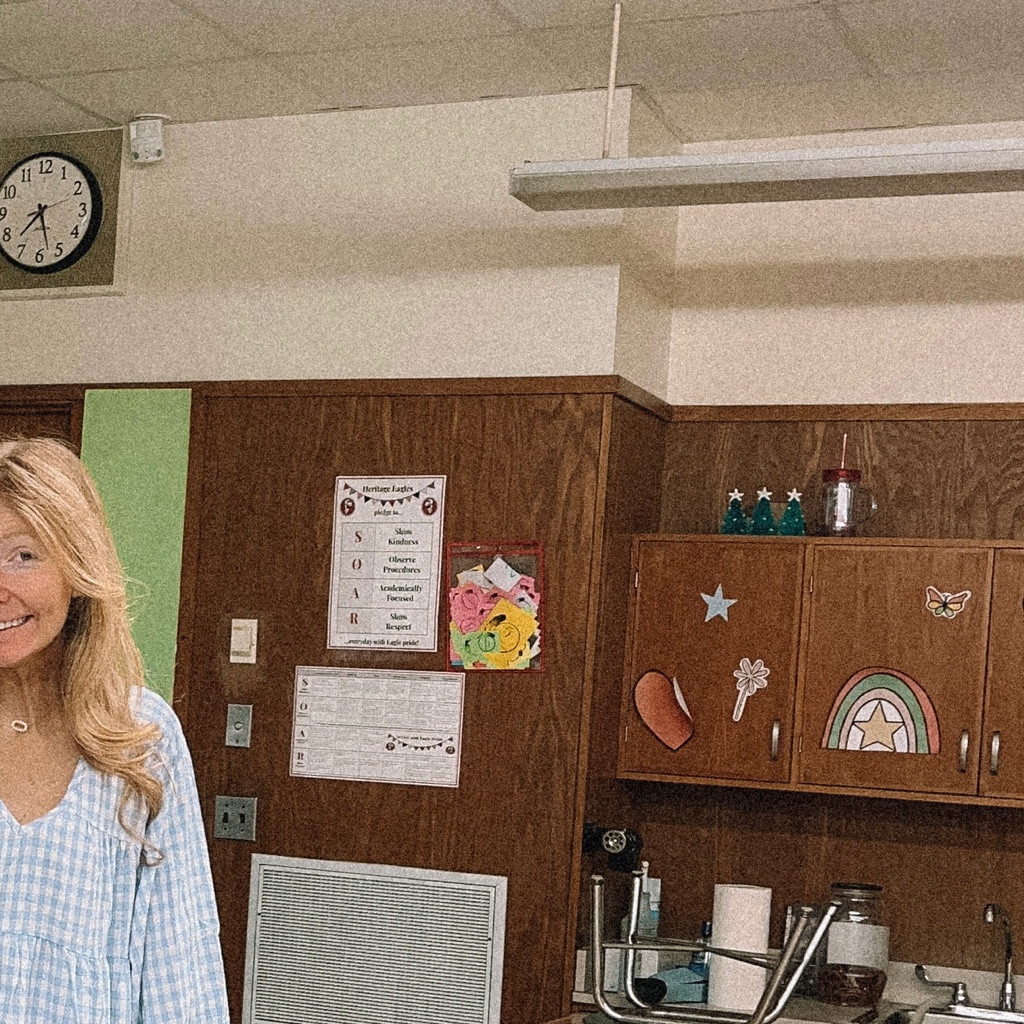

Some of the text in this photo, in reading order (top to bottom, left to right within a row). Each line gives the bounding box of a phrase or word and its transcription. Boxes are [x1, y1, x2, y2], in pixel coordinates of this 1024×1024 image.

[38, 159, 54, 174] 12
[61, 166, 67, 180] 1
[21, 168, 31, 182] 11
[3, 184, 17, 200] 10
[73, 180, 83, 196] 2
[78, 202, 87, 217] 3
[2, 227, 11, 242] 8
[70, 224, 80, 239] 4
[17, 244, 26, 259] 7
[35, 248, 45, 263] 6
[54, 242, 64, 257] 5
[362, 485, 414, 494] Heritage Eagles
[354, 530, 363, 543] S
[388, 538, 419, 546] Kindness
[352, 558, 362, 571] O
[388, 556, 416, 564] Observe
[383, 565, 421, 574] Procedures
[350, 587, 359, 599] A
[379, 584, 423, 593] Academically
[349, 612, 359, 625] R
[385, 623, 412, 632] Respect
